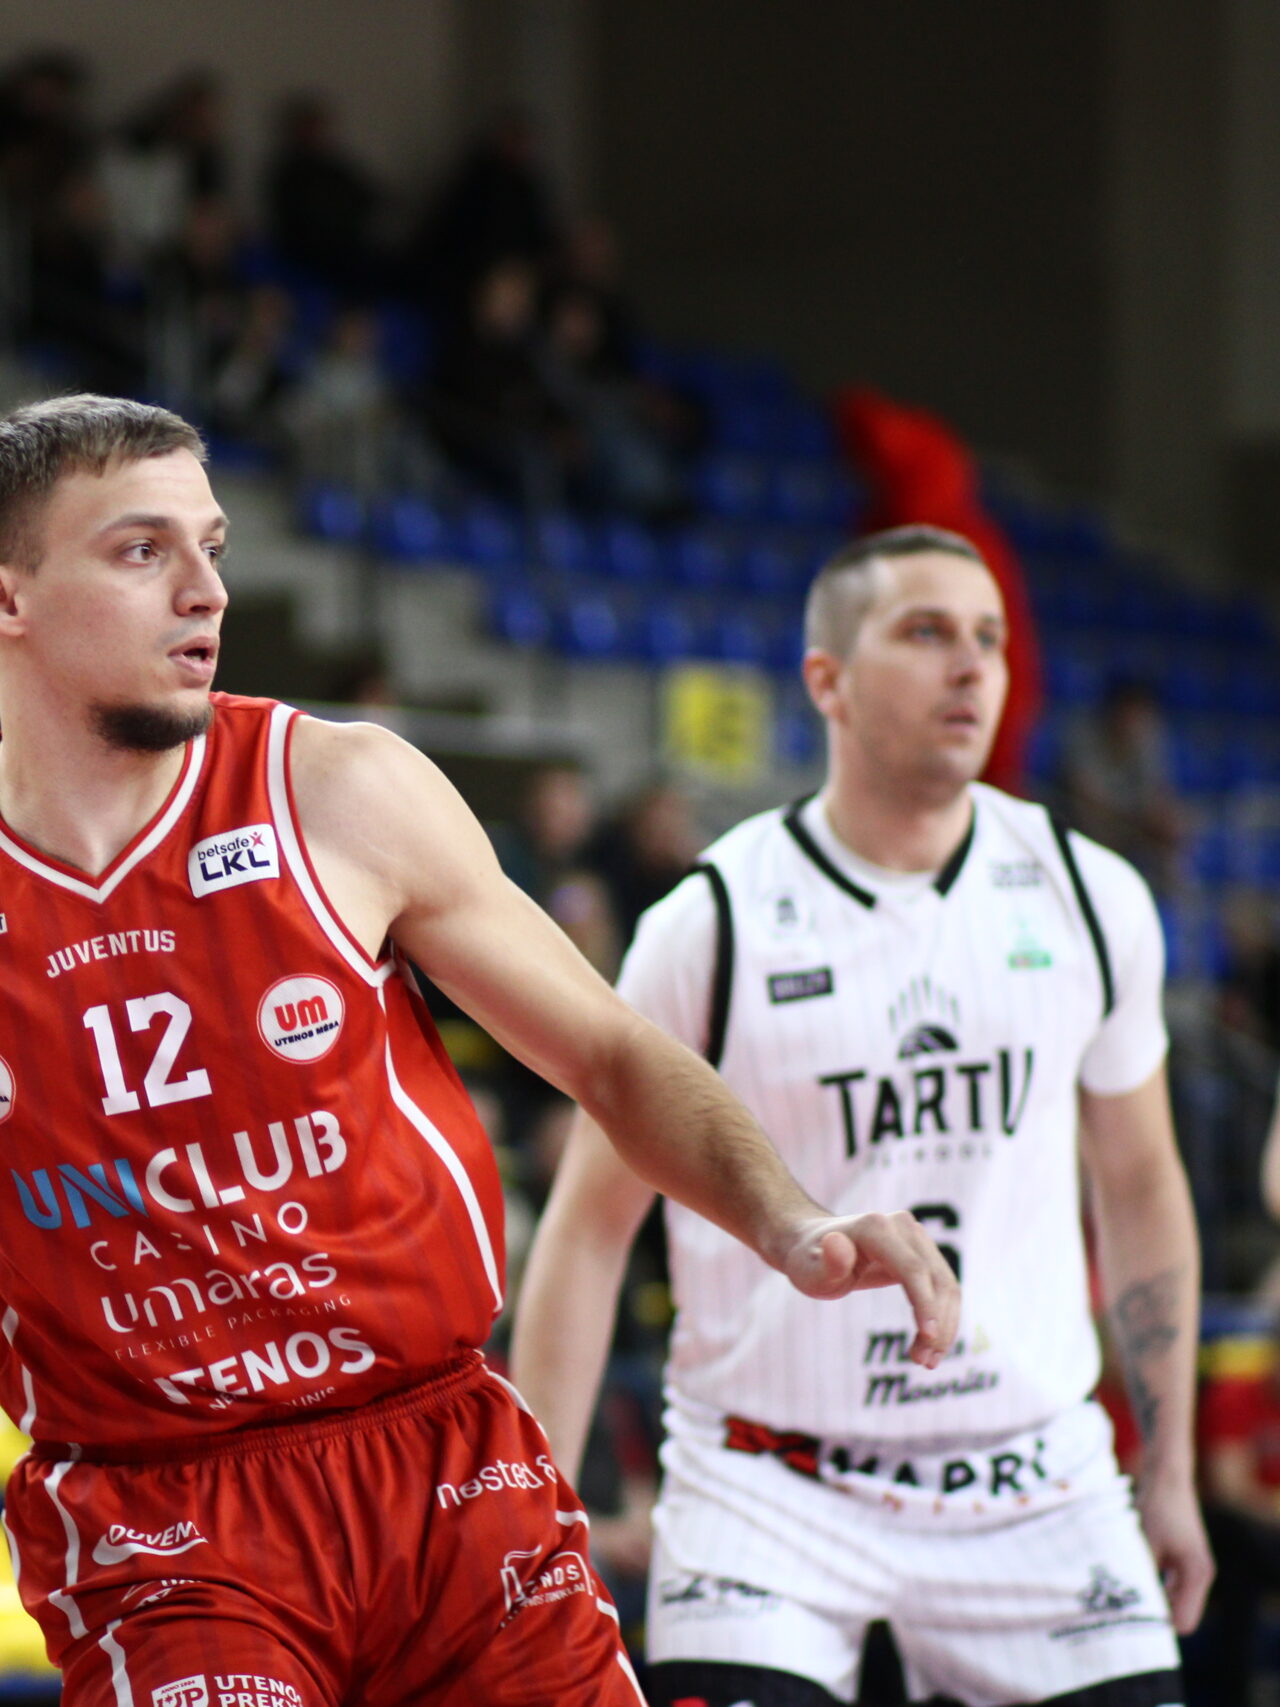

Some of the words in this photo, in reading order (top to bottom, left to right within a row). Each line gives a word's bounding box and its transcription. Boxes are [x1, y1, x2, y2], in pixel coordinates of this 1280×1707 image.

[197, 836, 250, 861] betsafe
[200, 849, 271, 881] LKL
[46, 930, 176, 978] JUVENTUS
[83, 991, 213, 1116] 12
[274, 1030, 314, 1047] UTENOS
[818, 1045, 1034, 1160] TARTU
[11, 1110, 347, 1230] UNICLUB
[101, 1252, 338, 1333] umaras
[115, 1325, 217, 1360] FLEXIBLE
[227, 1294, 352, 1330] PACKAGING
